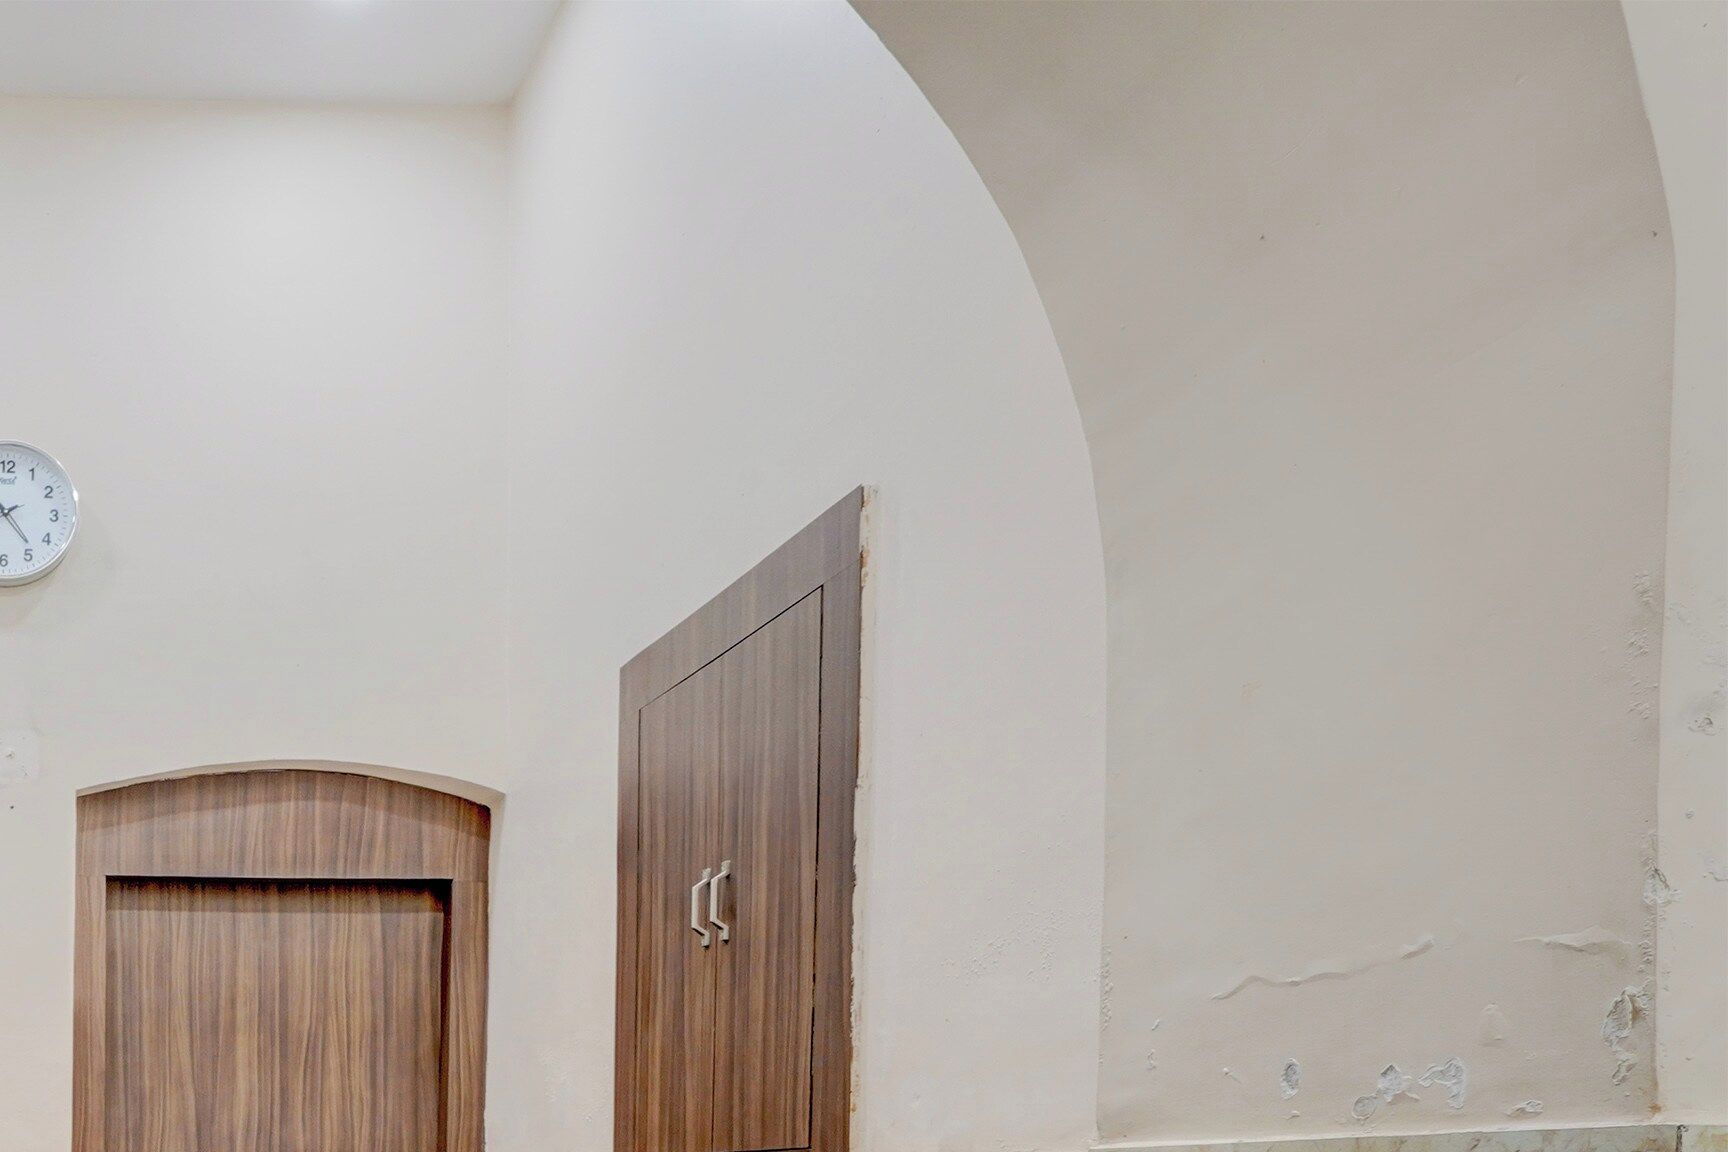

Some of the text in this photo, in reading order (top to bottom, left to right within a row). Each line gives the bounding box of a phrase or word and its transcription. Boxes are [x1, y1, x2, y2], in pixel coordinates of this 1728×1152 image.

[0, 460, 16, 474] 12
[28, 467, 36, 481] 1
[43, 485, 54, 499] 2
[49, 509, 60, 523] 3
[41, 532, 52, 546] 4
[23, 548, 34, 562] 5
